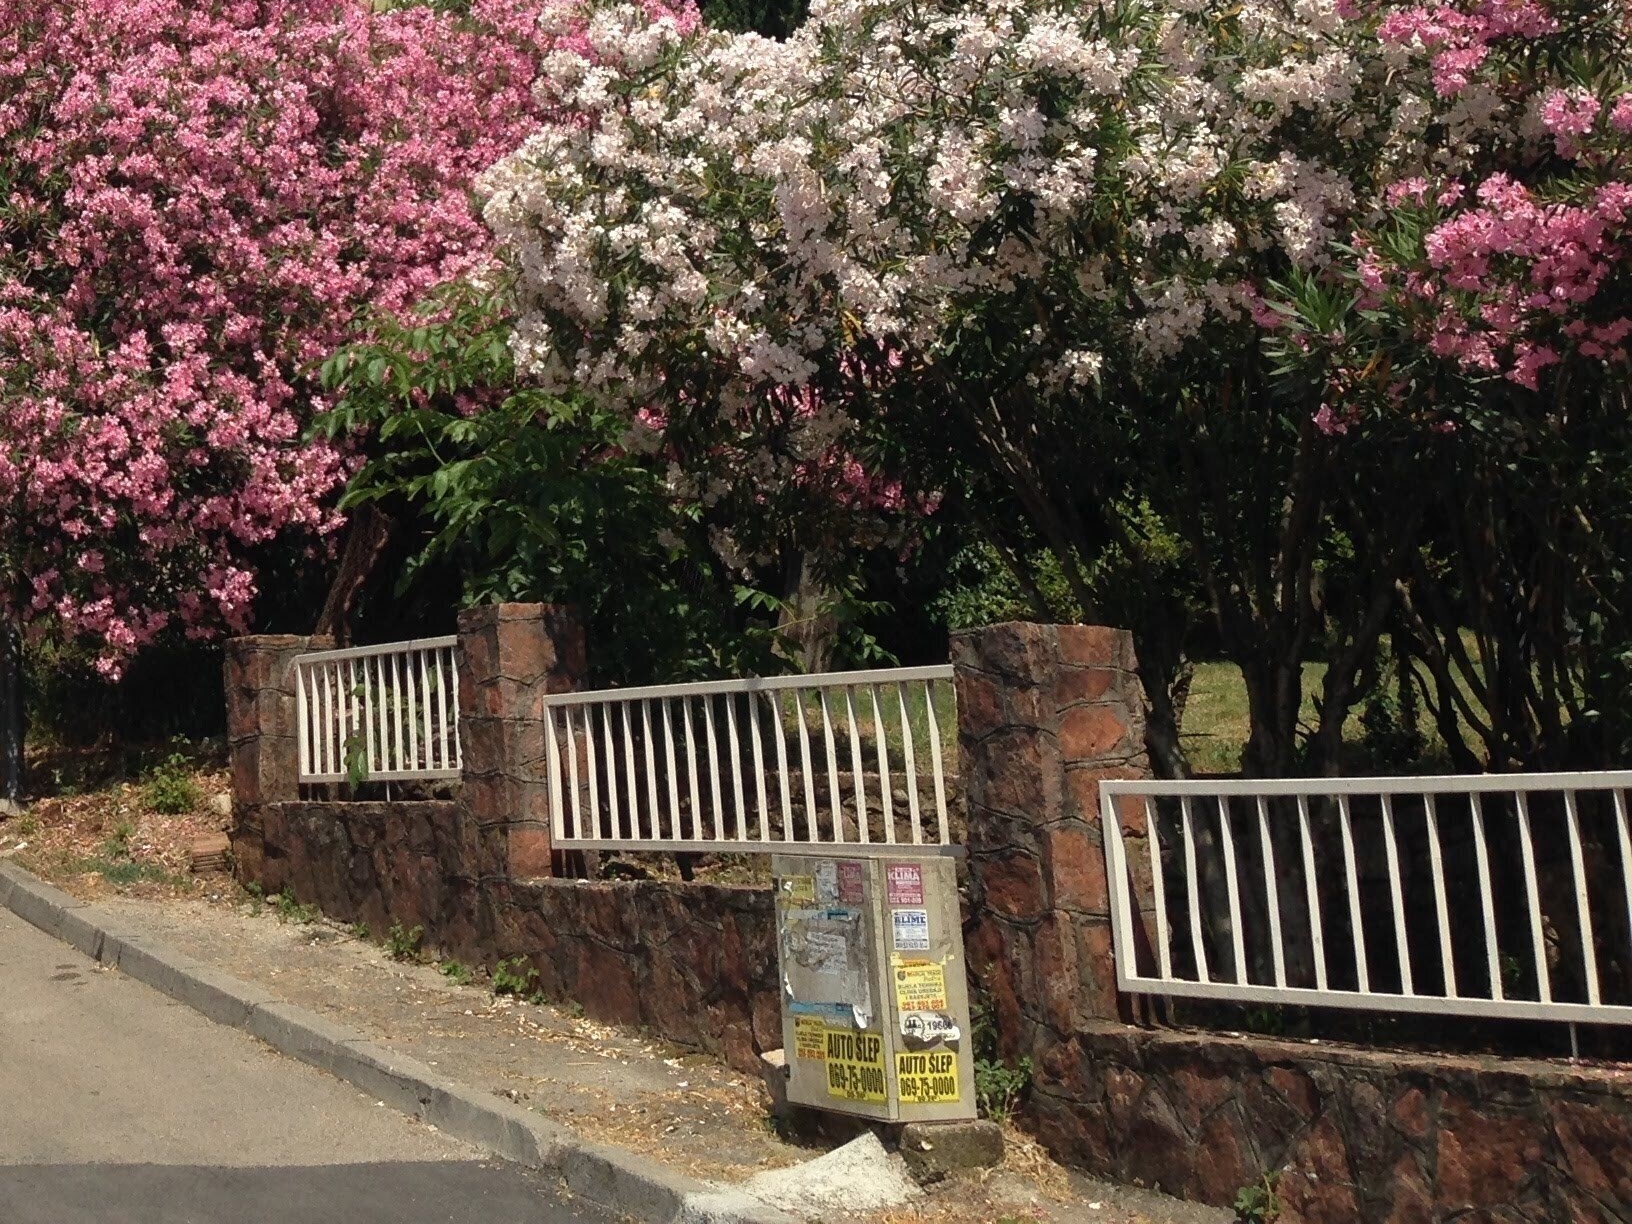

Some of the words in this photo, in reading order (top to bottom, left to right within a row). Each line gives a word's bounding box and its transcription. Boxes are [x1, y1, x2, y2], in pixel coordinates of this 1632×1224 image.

[887, 870, 920, 881] KLIMA
[827, 1033, 853, 1061] AUTO
[899, 1055, 926, 1075] AUTO
[829, 1062, 884, 1094] 069-75-0000
[900, 1076, 955, 1096] 069-75-0000
